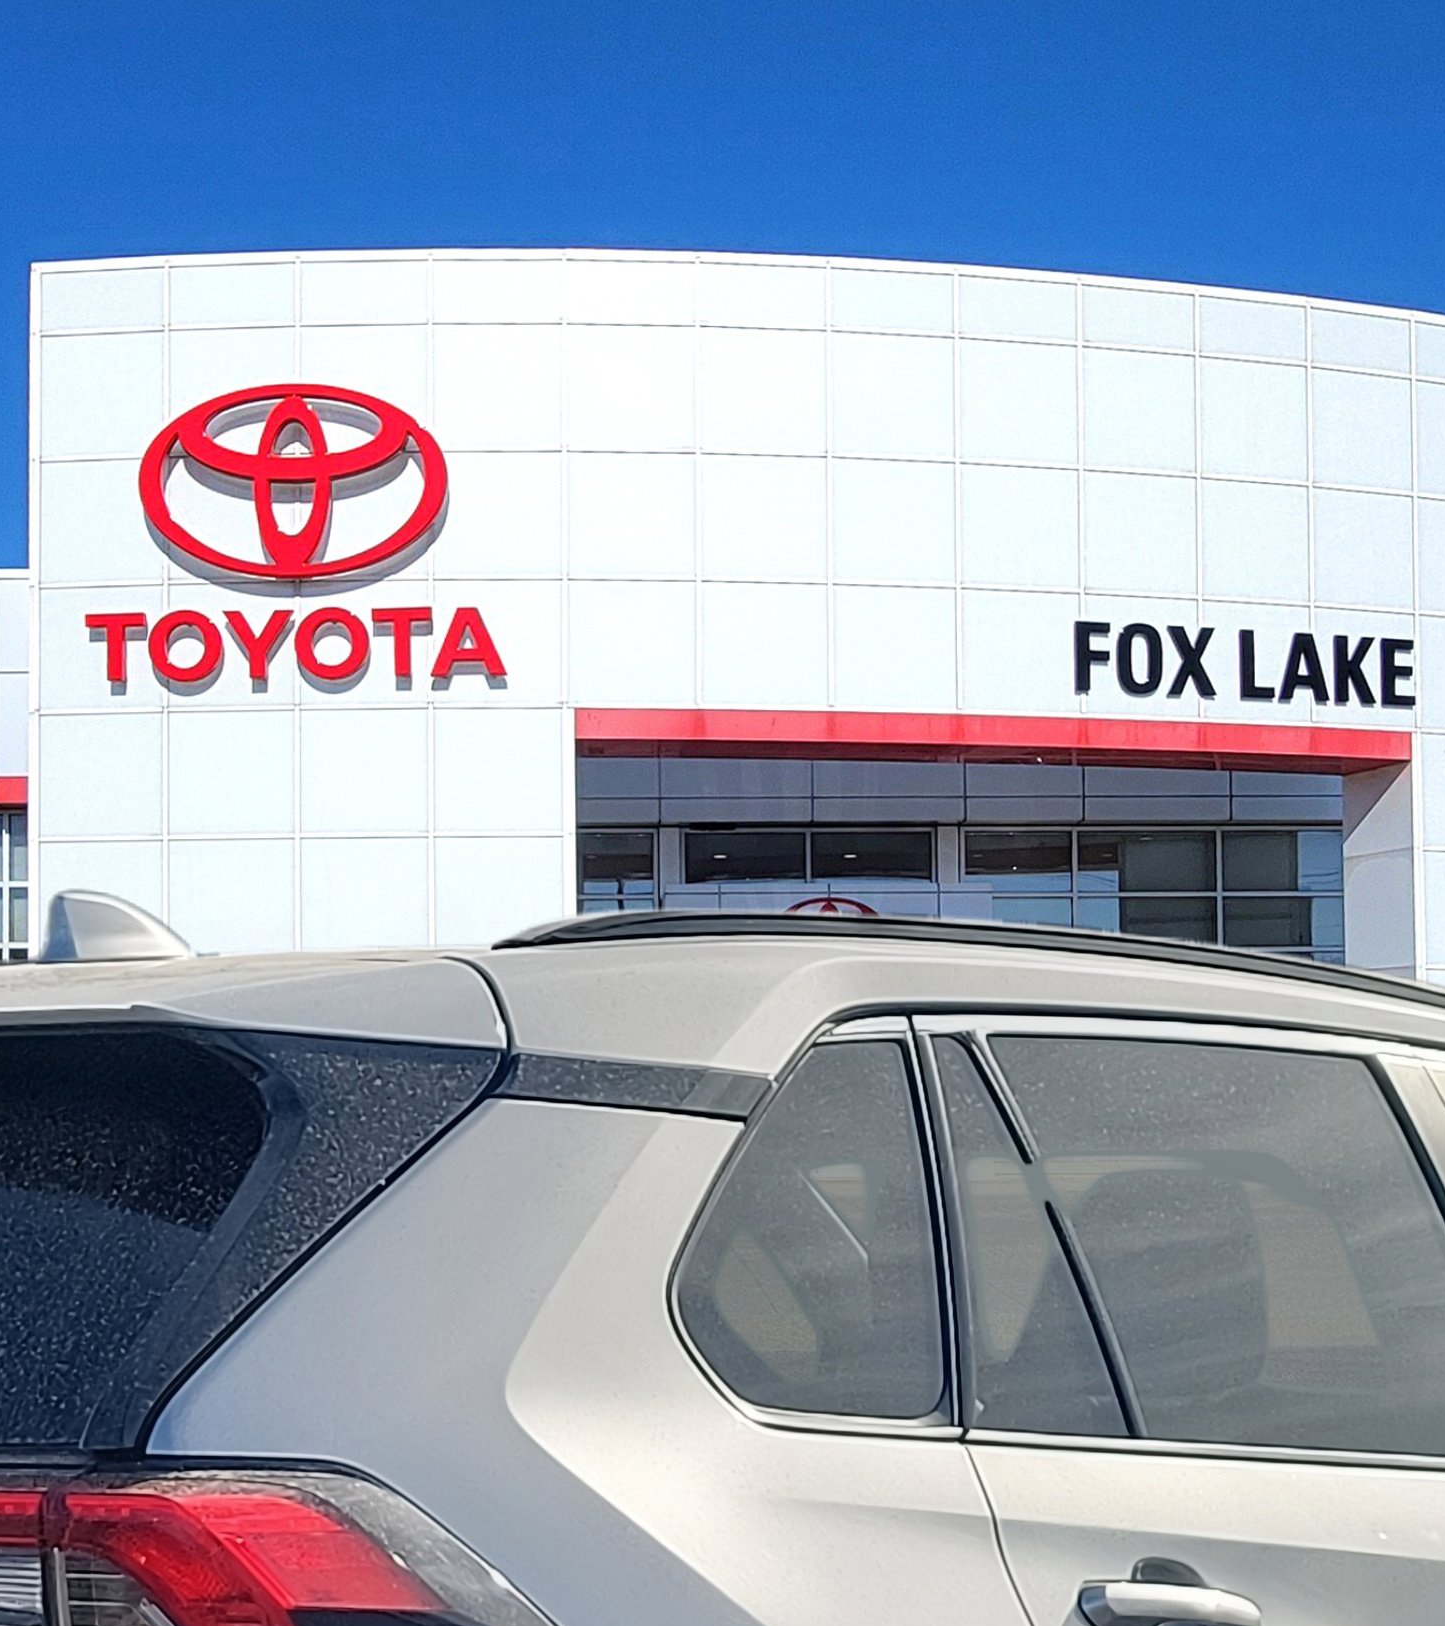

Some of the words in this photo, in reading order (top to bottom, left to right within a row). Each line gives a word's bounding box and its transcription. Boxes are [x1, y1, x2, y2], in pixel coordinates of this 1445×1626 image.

[84, 606, 509, 686] TOYOTA
[1074, 620, 1217, 700] FOX
[1238, 629, 1417, 708] LAKE
